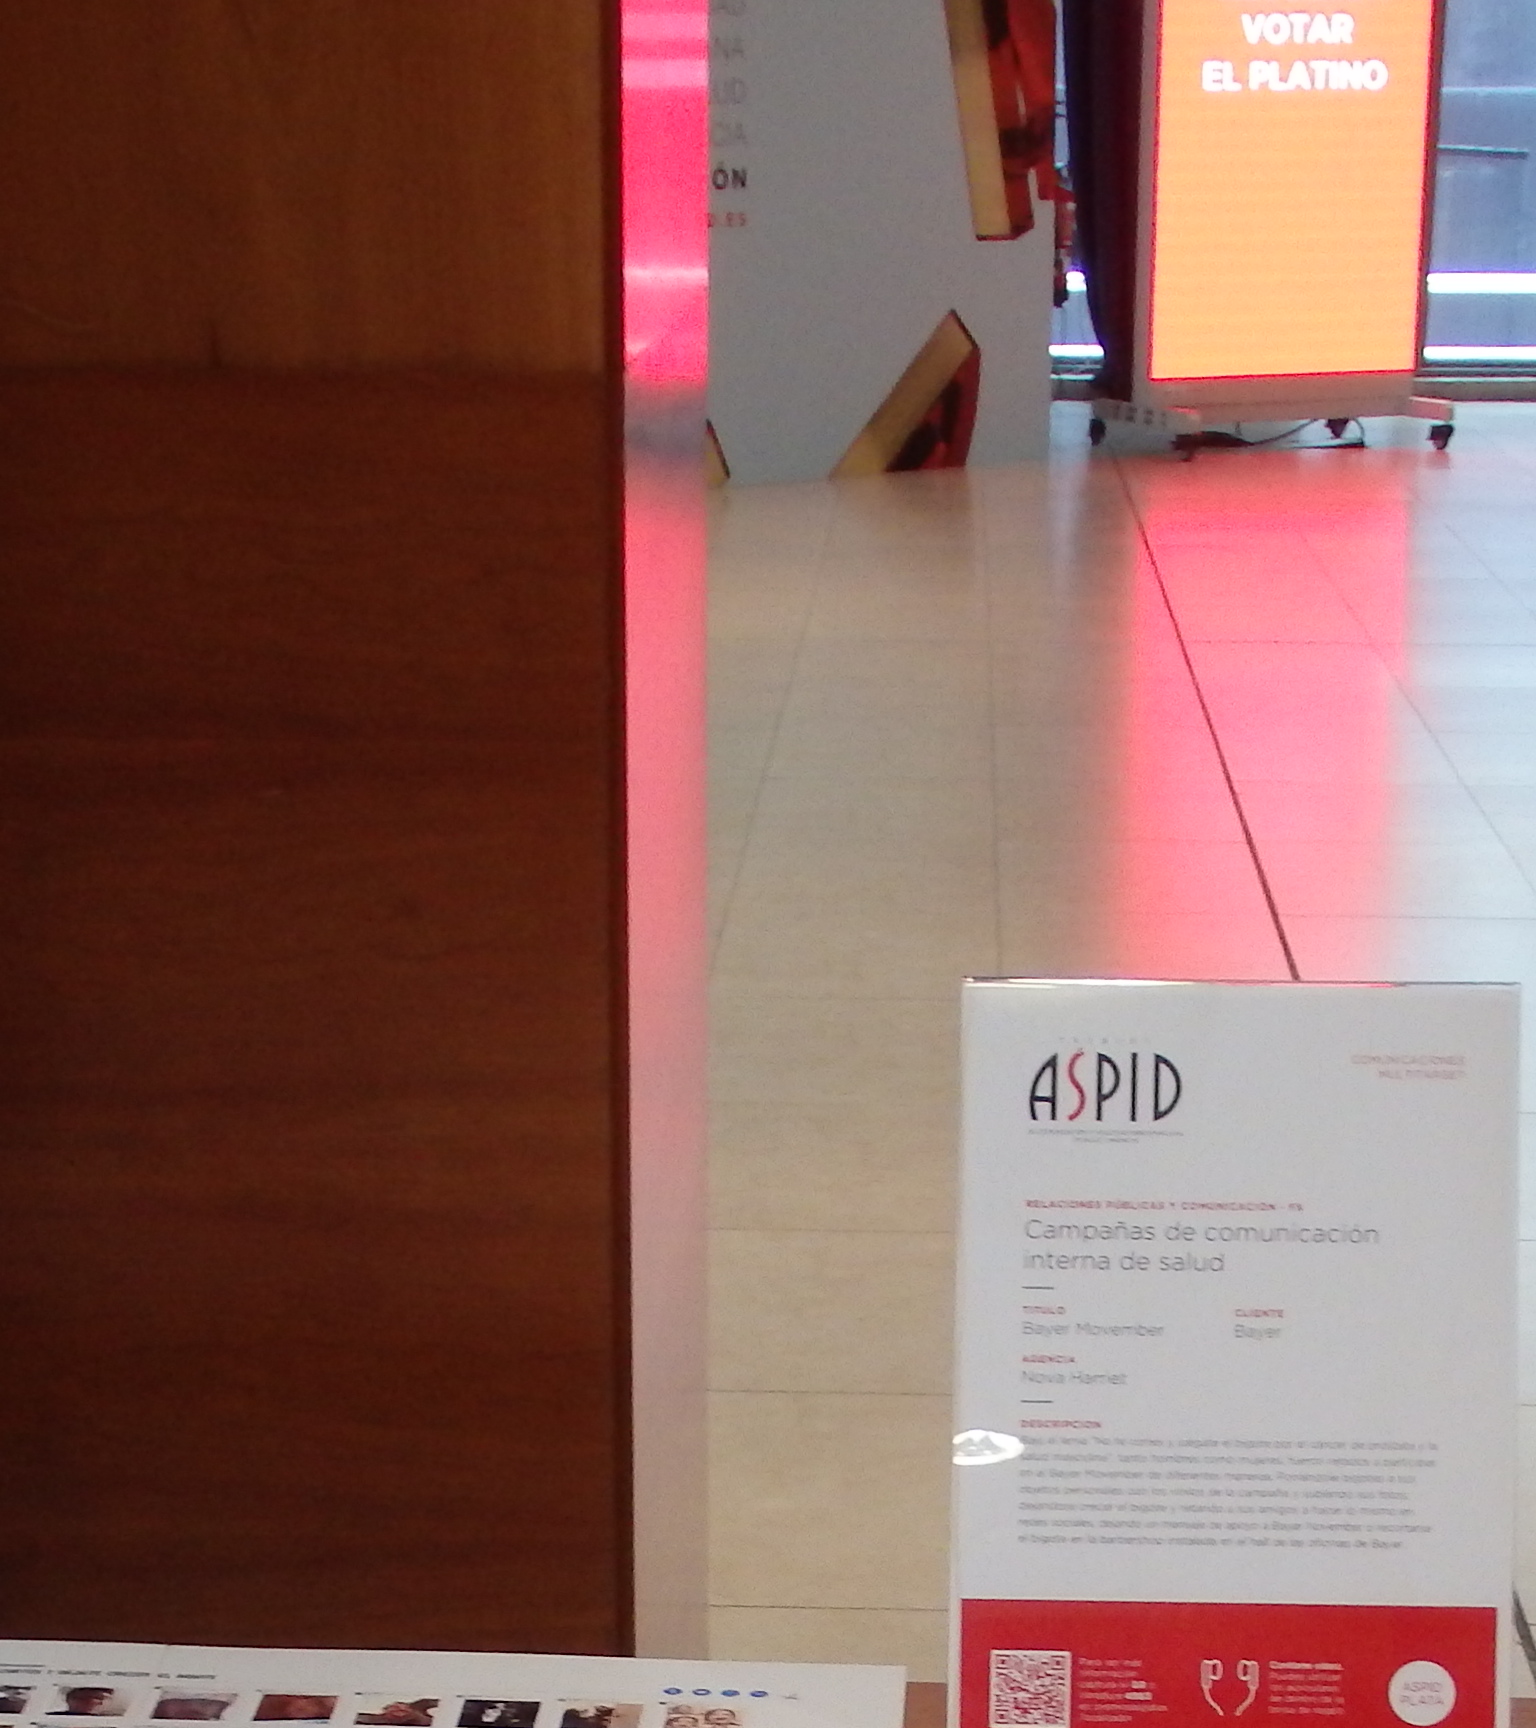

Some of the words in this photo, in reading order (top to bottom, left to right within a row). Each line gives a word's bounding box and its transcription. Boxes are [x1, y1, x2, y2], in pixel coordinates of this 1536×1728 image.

[1240, 12, 1354, 45] VOTAR
[1201, 60, 1241, 92] EL
[1248, 58, 1389, 93] PLATINO
[1029, 1049, 1183, 1122] ASPID
[1024, 1219, 1156, 1243] Campañas
[1166, 1221, 1196, 1242] de
[1205, 1222, 1380, 1244] comunicación
[1022, 1251, 1111, 1271] interna
[1120, 1252, 1151, 1272] de
[1159, 1252, 1226, 1273] salud
